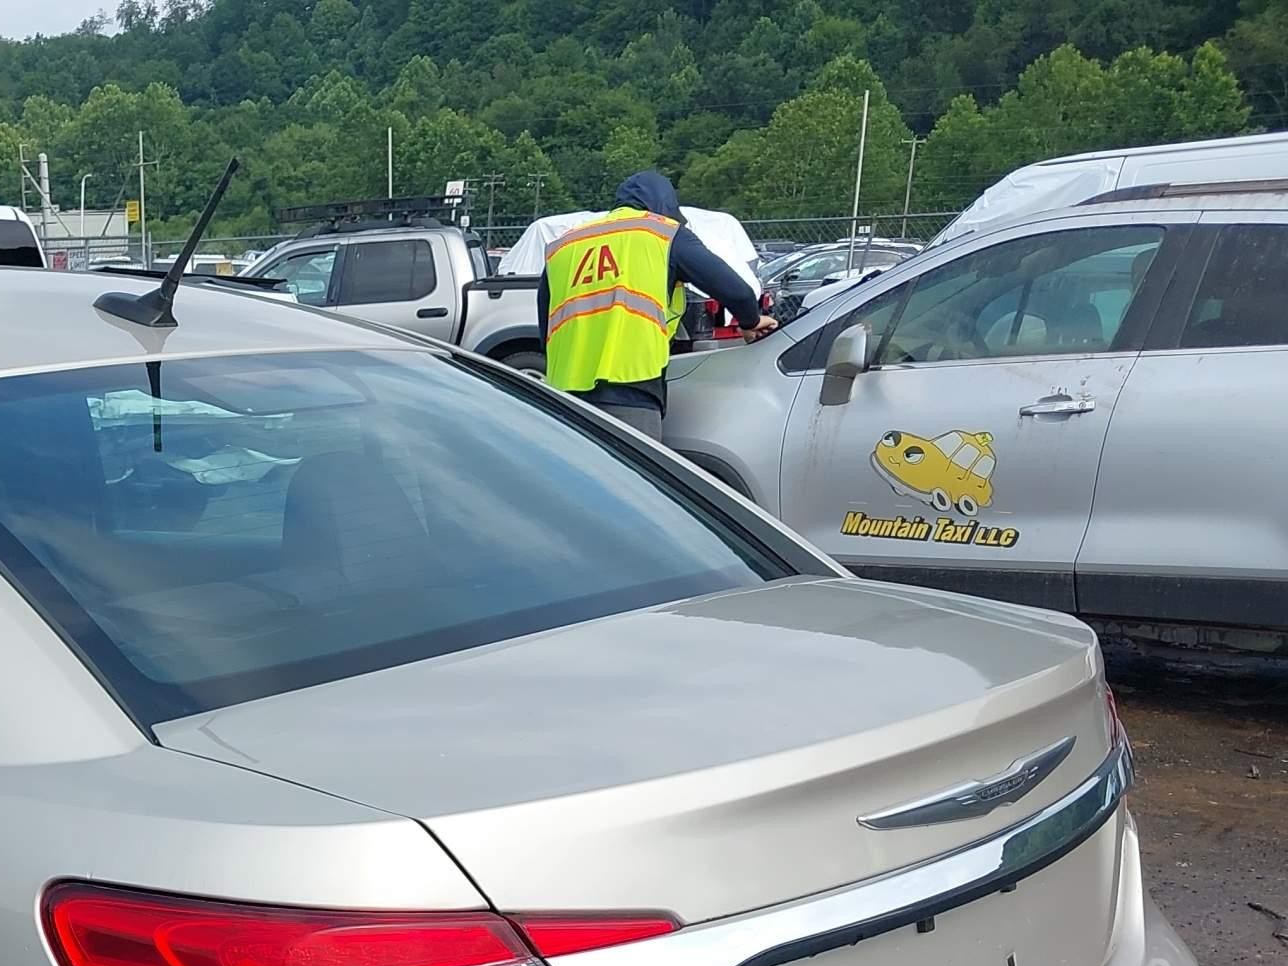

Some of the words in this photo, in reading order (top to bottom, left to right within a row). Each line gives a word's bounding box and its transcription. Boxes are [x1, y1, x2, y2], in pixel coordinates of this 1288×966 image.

[841, 511, 931, 541] Mountain
[933, 517, 978, 544] Taxi
[975, 526, 1020, 547] LLC
